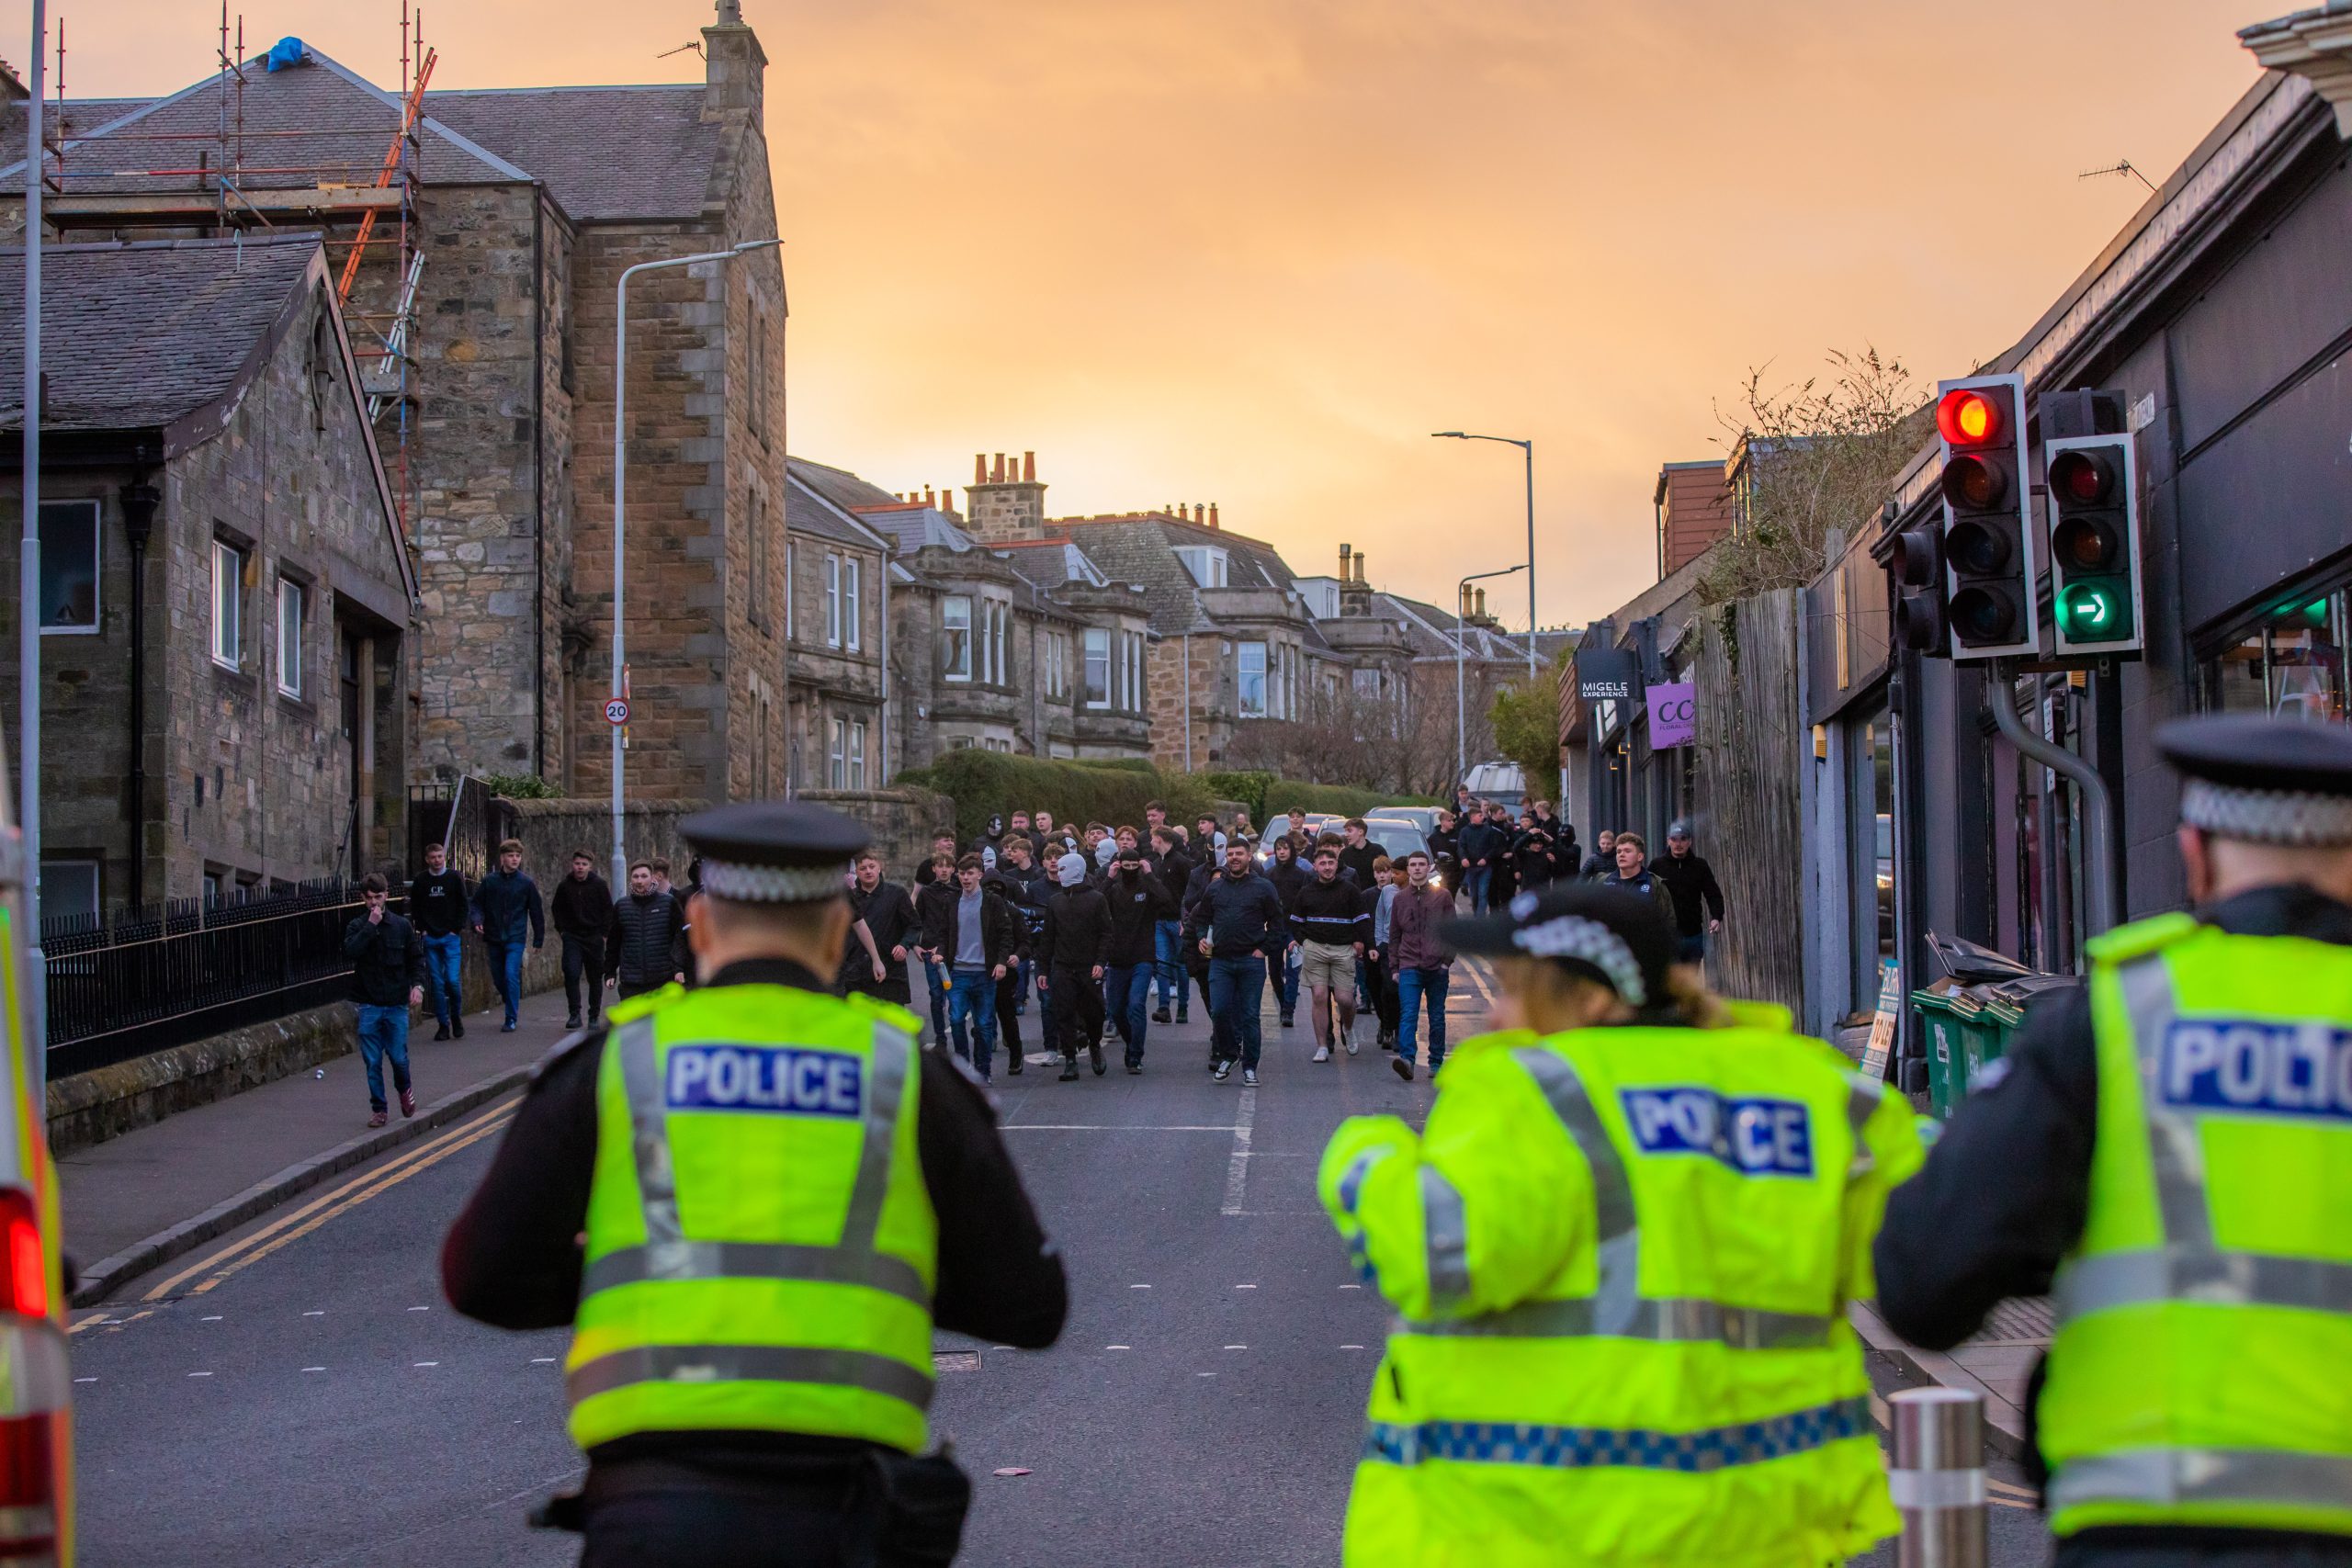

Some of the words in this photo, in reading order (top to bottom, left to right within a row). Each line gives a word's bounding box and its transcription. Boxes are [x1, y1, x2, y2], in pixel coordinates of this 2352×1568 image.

[1582, 682, 1628, 691] MIGELE
[608, 705, 627, 716] 20
[671, 1050, 856, 1111] POLICE
[1632, 1093, 1806, 1170] POCE
